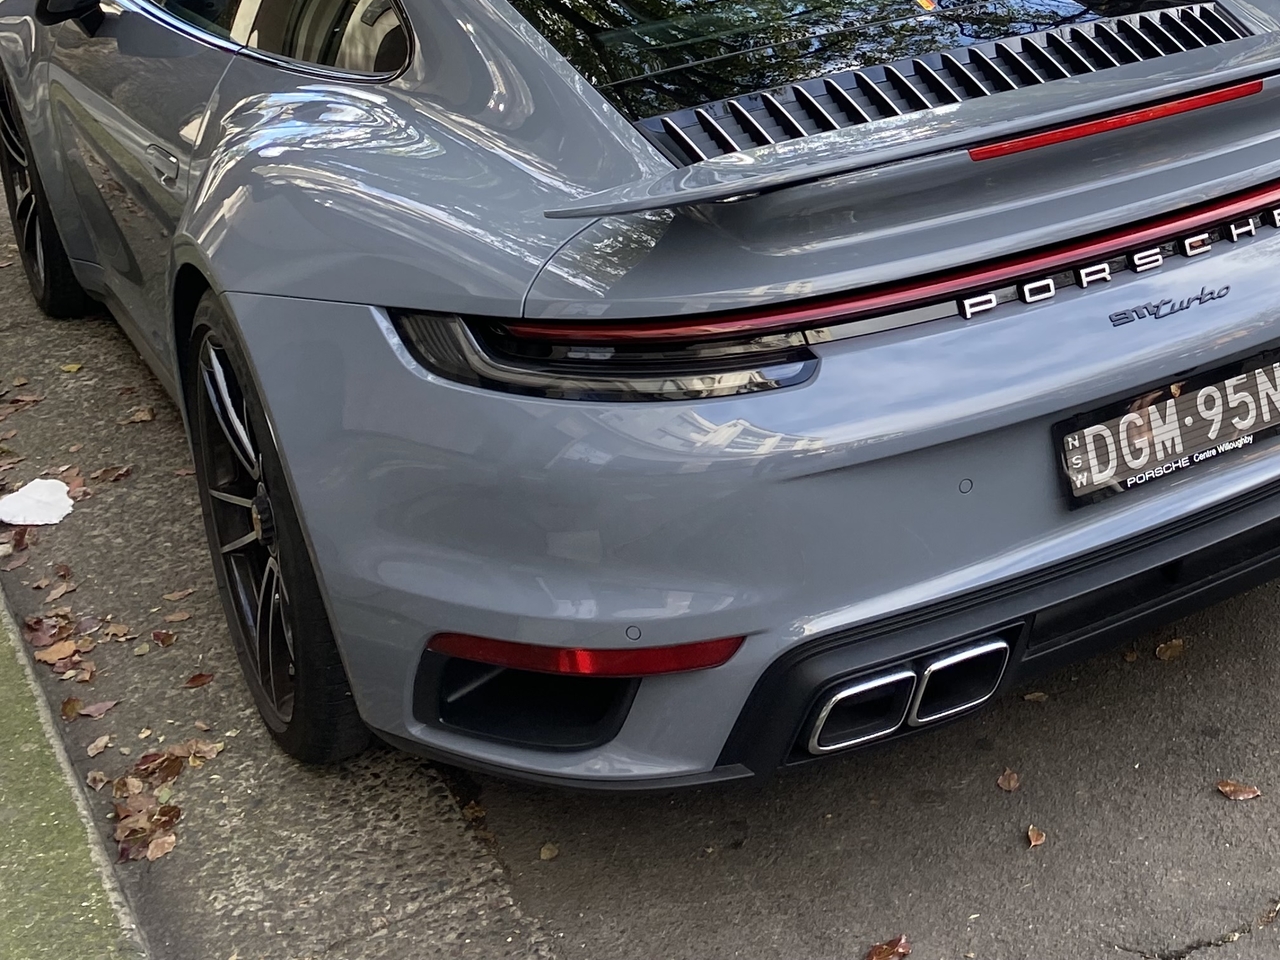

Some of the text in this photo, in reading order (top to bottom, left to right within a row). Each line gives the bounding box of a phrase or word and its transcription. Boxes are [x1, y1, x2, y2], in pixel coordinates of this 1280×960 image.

[1127, 435, 1254, 488] PORSCHE Centre Willoughby
